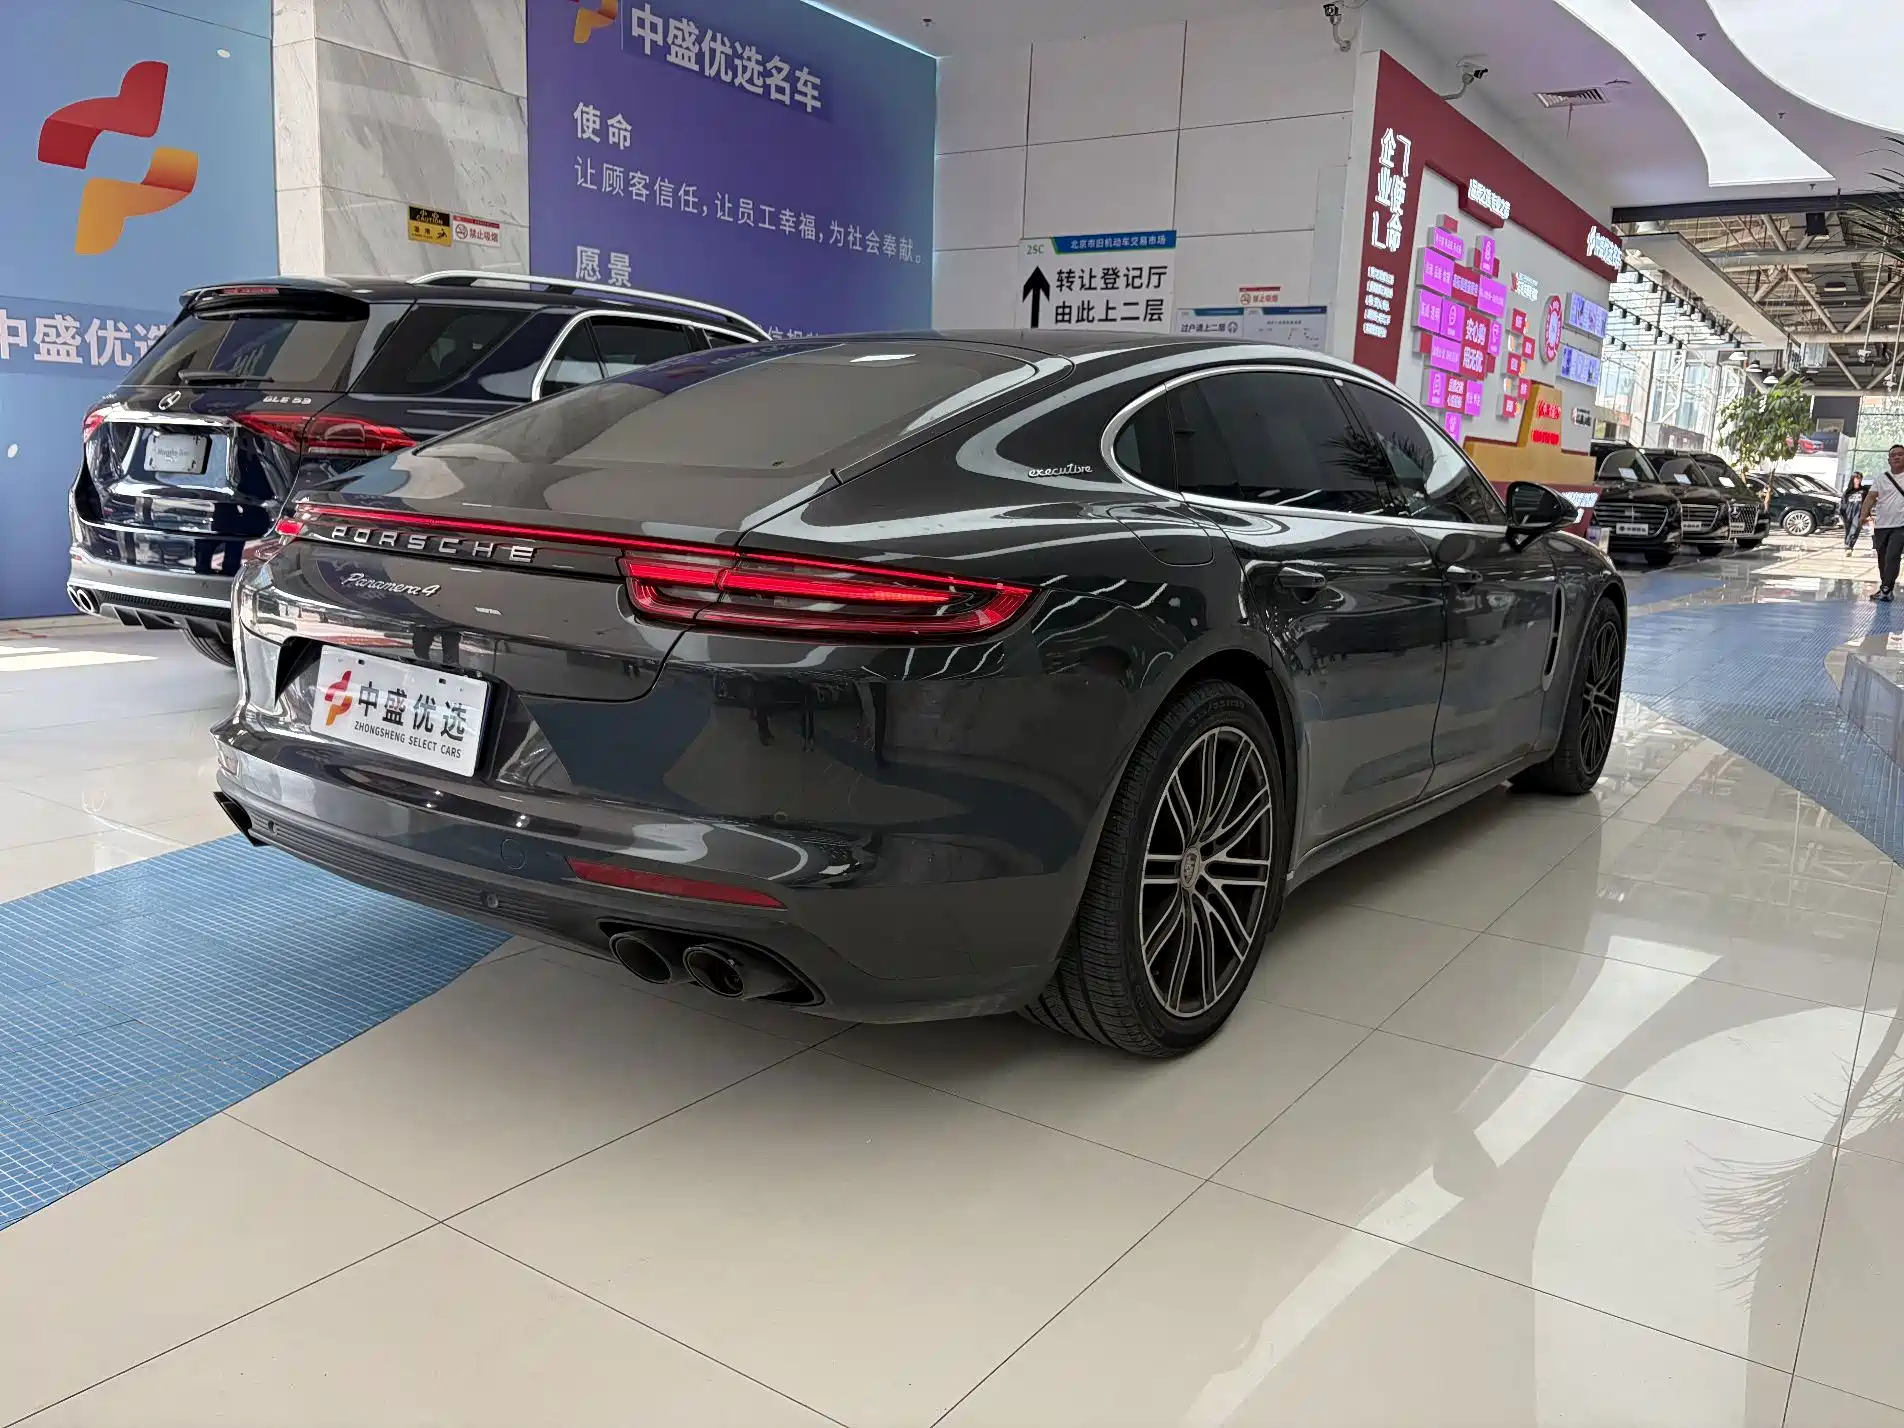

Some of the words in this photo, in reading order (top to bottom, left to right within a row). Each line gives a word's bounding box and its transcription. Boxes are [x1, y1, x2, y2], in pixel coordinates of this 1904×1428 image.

[631, 4, 822, 113] 中盛优选名车
[573, 101, 633, 151] 使命
[416, 215, 443, 225] CAUTION
[1070, 235, 1166, 249] 北京市旧机动车交易市场
[575, 245, 632, 288] 愿景
[1055, 265, 1168, 293] 转让登记厅
[1054, 298, 1164, 325] 由此上二层
[1028, 463, 1092, 477] executive
[332, 526, 534, 563] PORSCHE
[358, 681, 467, 742] 中盛优选
[354, 721, 406, 744] ZHONGSHENG
[408, 735, 437, 752] SELECT
[441, 744, 462, 759] CARS
